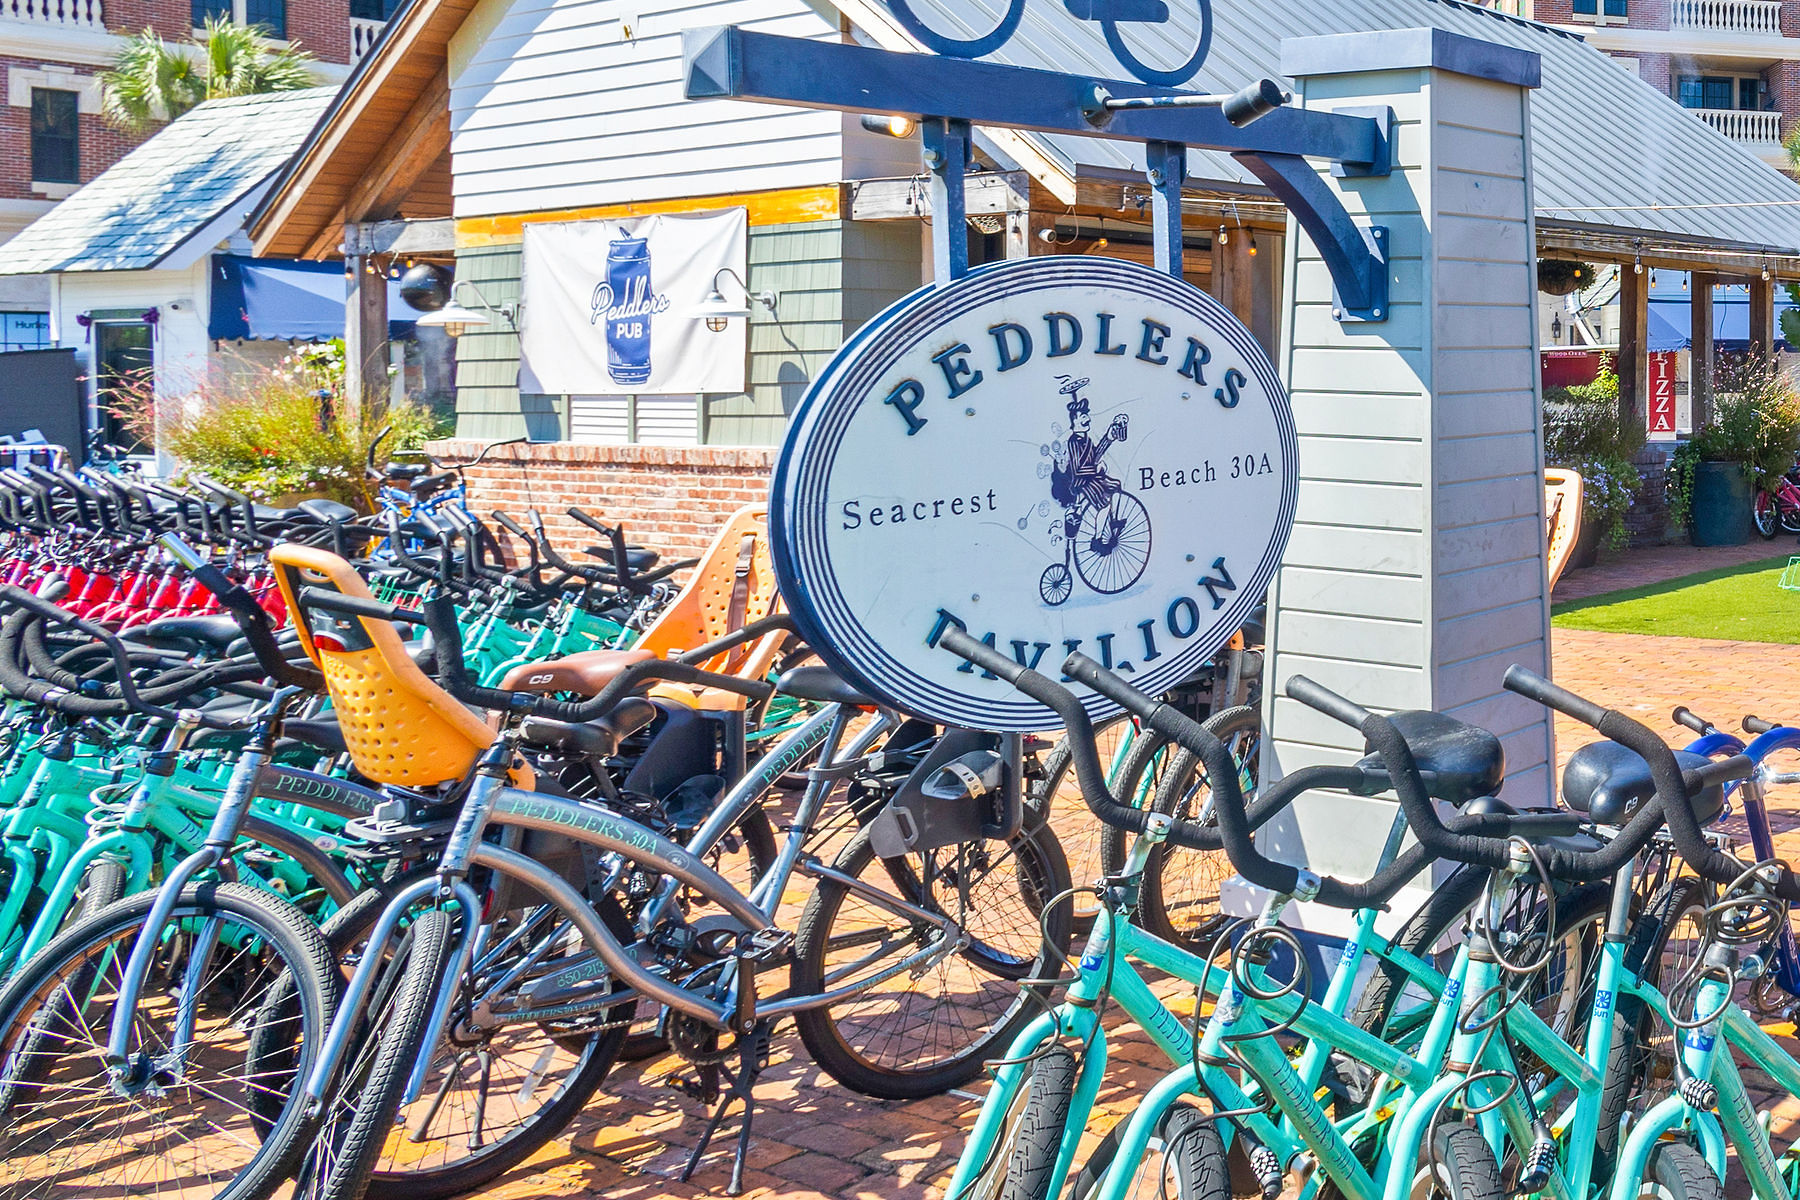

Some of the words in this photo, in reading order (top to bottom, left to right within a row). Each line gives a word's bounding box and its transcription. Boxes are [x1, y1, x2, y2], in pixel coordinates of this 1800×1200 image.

[588, 275, 671, 325] Peddlers
[616, 322, 643, 339] PUB
[884, 311, 1247, 436] PEDDLERS
[841, 487, 998, 531] Seacrest
[1138, 459, 1217, 491] Beach
[1230, 452, 1273, 480] 30A
[529, 673, 554, 685] C9
[762, 717, 836, 784] PEDDLER
[510, 799, 627, 841] PEDDLERS
[626, 830, 659, 856] 30A
[1624, 795, 1639, 814] C9
[1593, 1008, 1609, 1019] Sun
